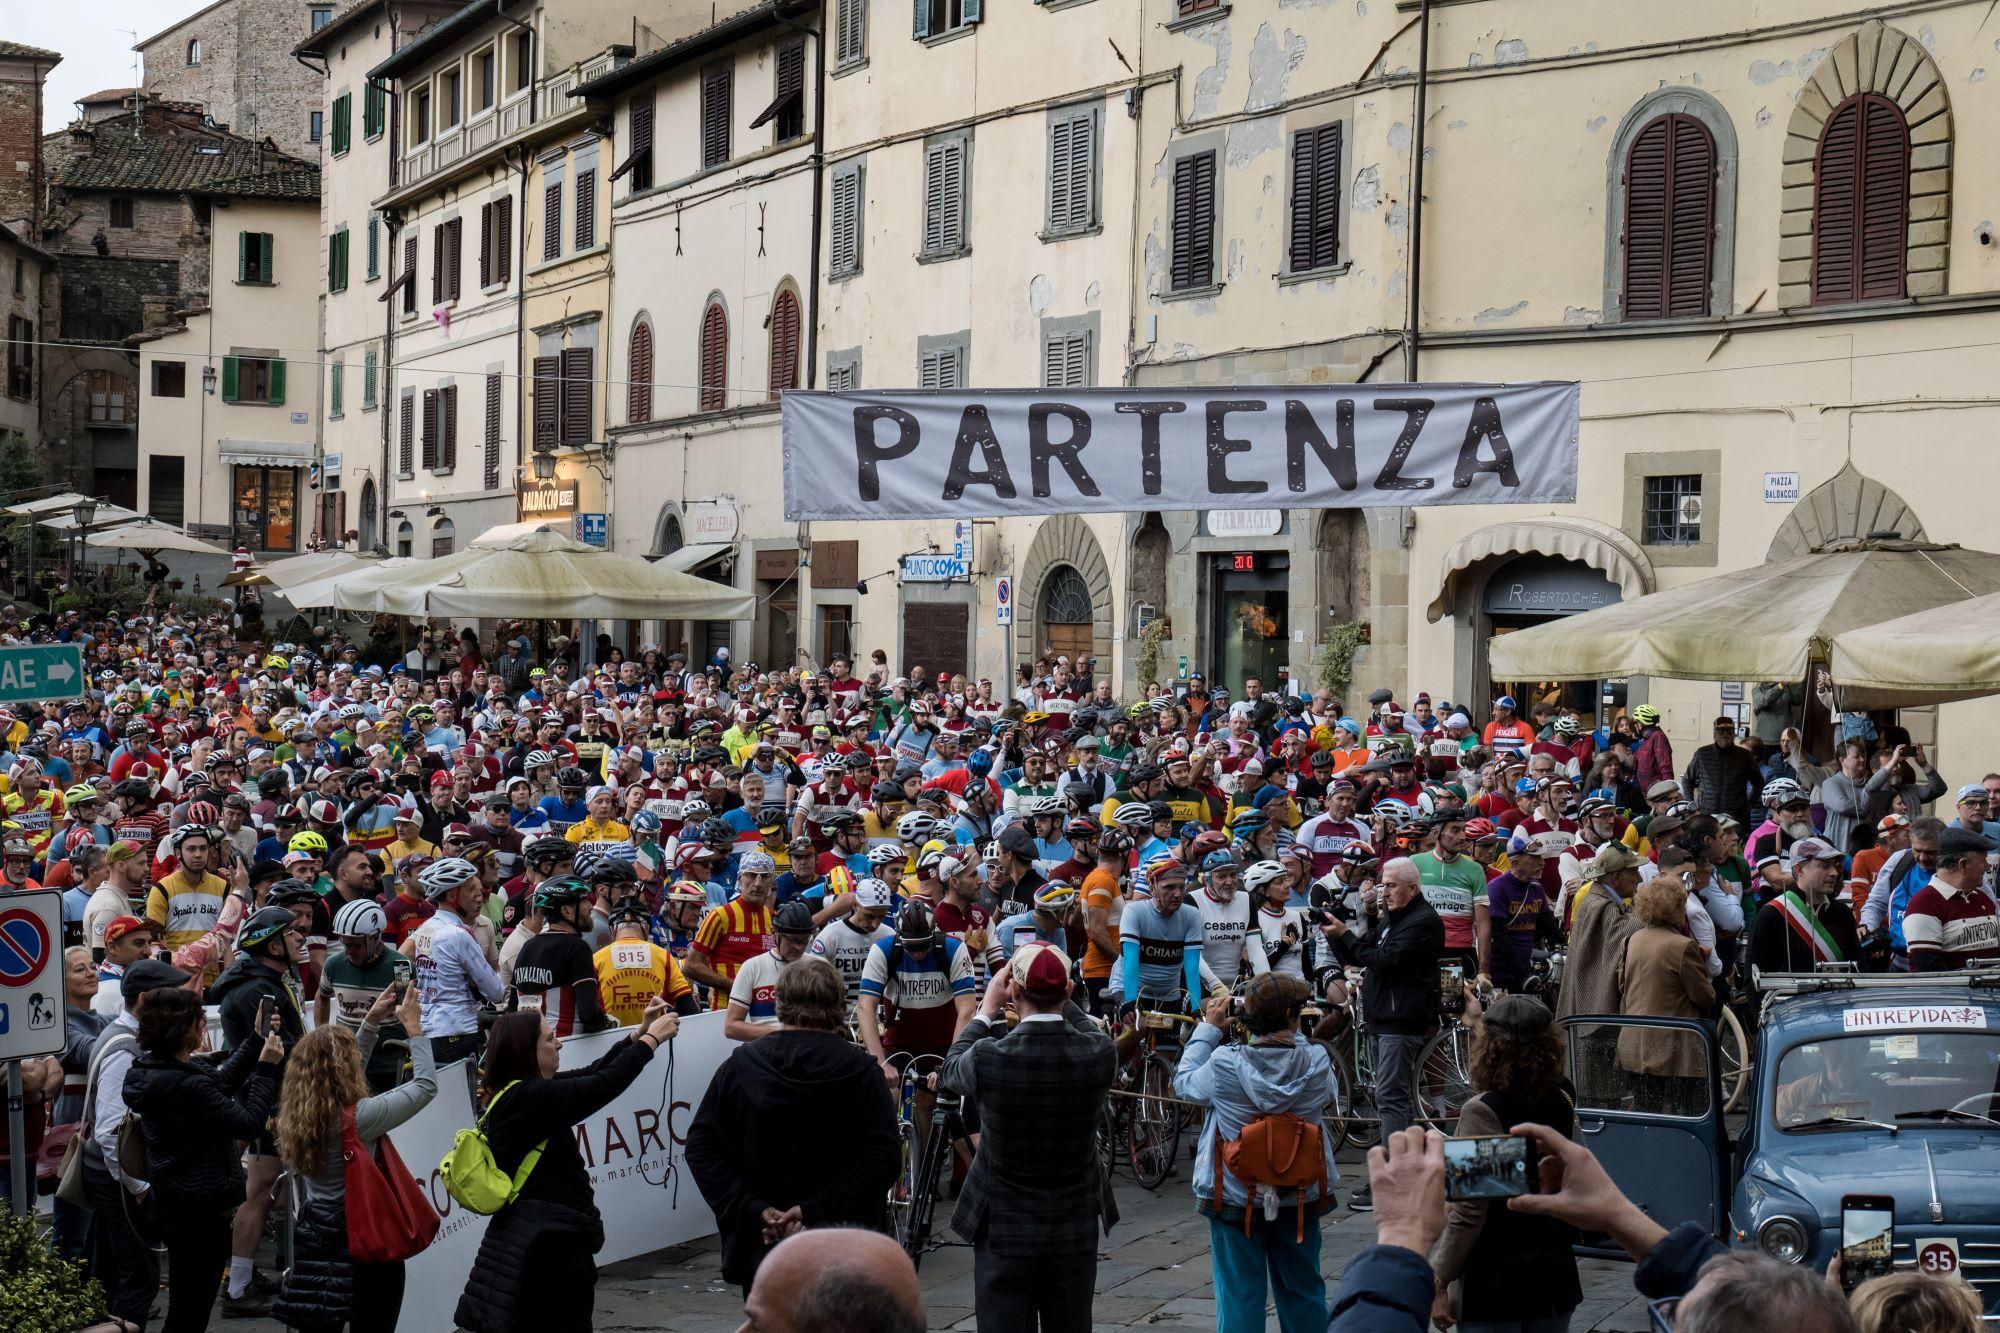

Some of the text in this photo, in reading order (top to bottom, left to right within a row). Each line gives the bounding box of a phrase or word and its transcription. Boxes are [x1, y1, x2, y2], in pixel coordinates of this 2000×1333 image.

[852, 397, 1520, 502] PARTENZA
[1770, 477, 1792, 486] PIAZZA
[1765, 489, 1798, 499] BALDACCIO
[522, 489, 559, 512] BALDACCIO
[695, 516, 733, 533] MACELLERIA
[1215, 510, 1272, 530] FARMACIA
[1496, 727, 1518, 737] PEUGEOT
[1427, 889, 1462, 900] Cesena
[200, 904, 218, 914] Bike
[1204, 920, 1246, 931] cesena
[418, 936, 430, 948] 816
[1210, 934, 1242, 944] vintage
[618, 951, 646, 963] 815
[1845, 1008, 1952, 1027] L'INTREPIDA
[1925, 1251, 1952, 1272] 35
